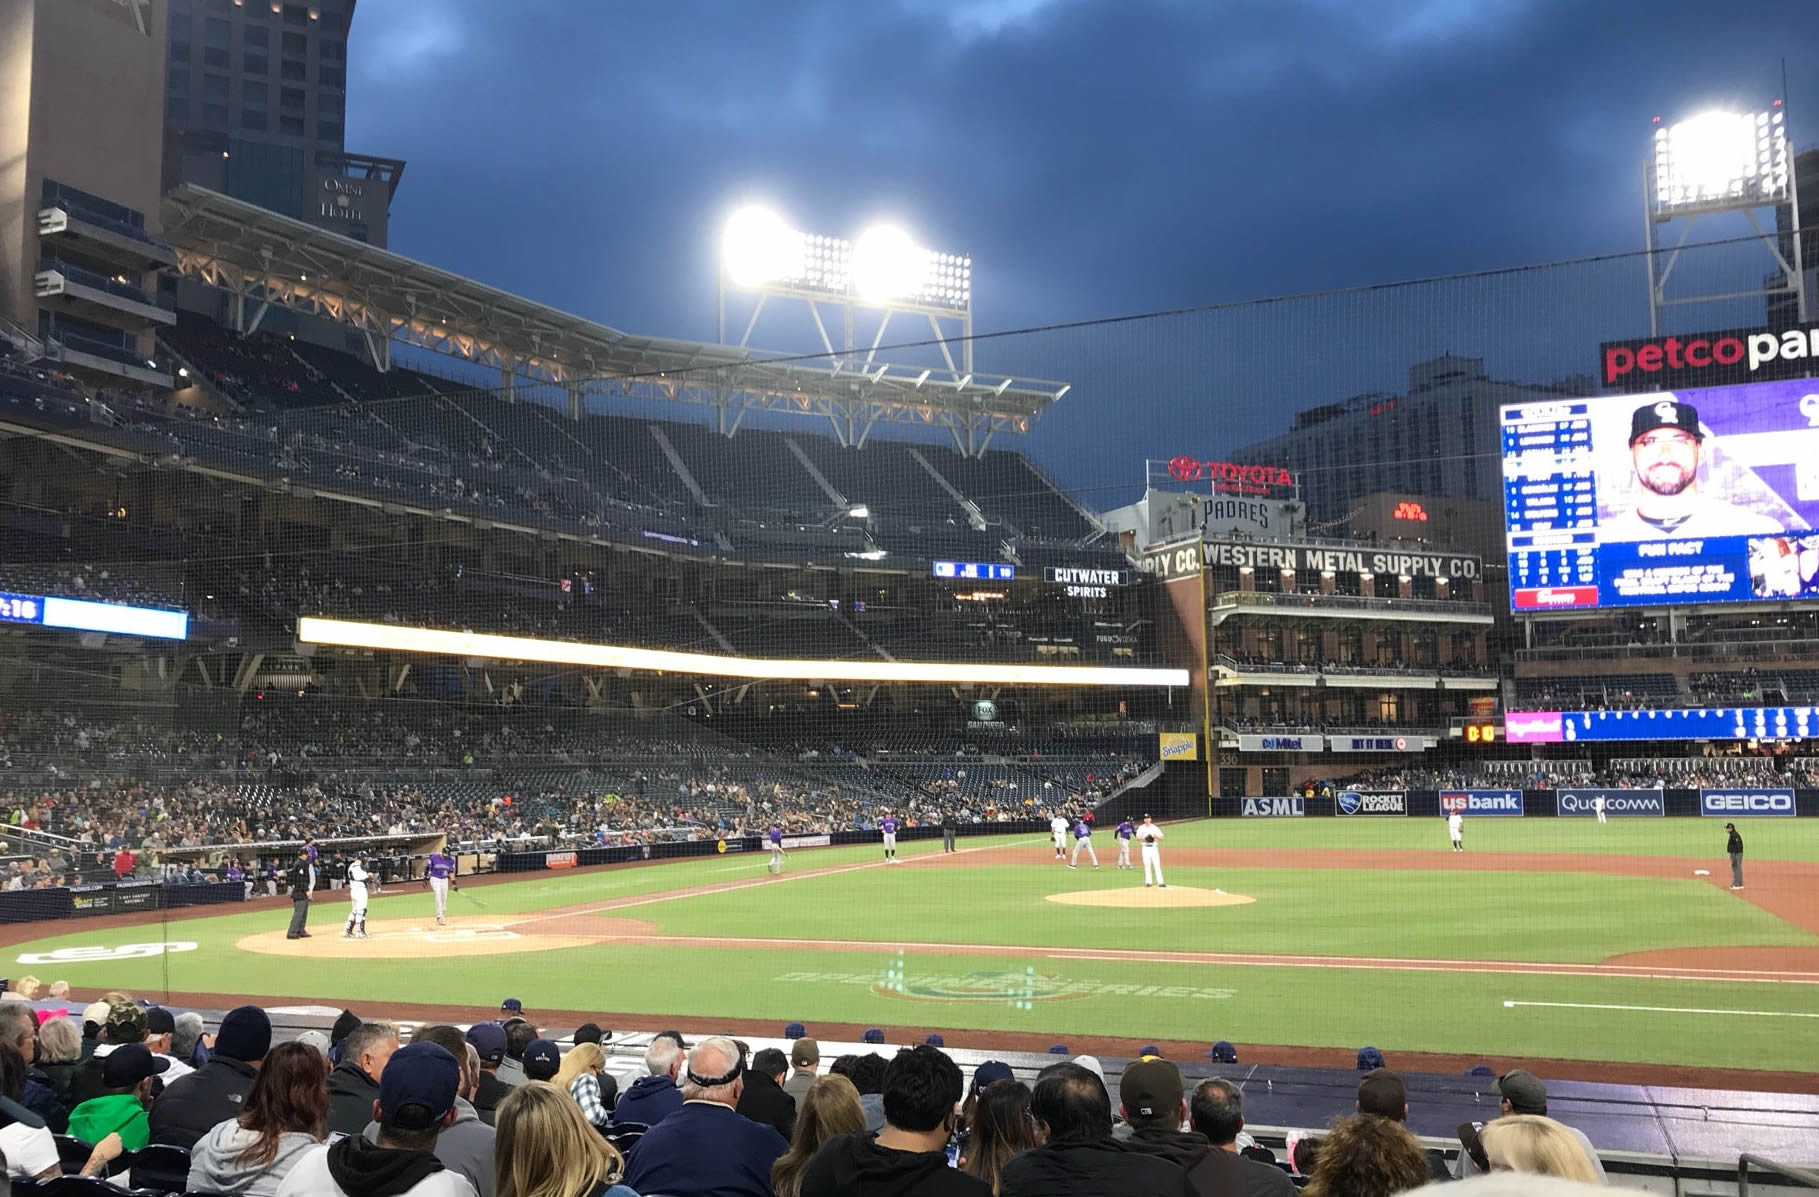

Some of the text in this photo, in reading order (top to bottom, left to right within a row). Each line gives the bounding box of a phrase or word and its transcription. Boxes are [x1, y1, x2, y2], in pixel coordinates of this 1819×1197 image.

[1207, 462, 1293, 487] TOYOTA
[1204, 499, 1269, 528] PADRES
[1176, 547, 1200, 573] CO.
[1203, 543, 1481, 578] WESTERN METAL SUPPLY CO.
[1054, 568, 1119, 584] CUTWATER
[1067, 586, 1107, 598] SPIRITS
[977, 705, 993, 714] FOX
[1162, 739, 1194, 757] Snapple
[1275, 738, 1303, 750] Mitel
[1243, 799, 1303, 815] ASML
[1362, 795, 1403, 804] ROCKET
[1362, 801, 1404, 812] LEAGUE
[1705, 794, 1792, 810] GEICO
